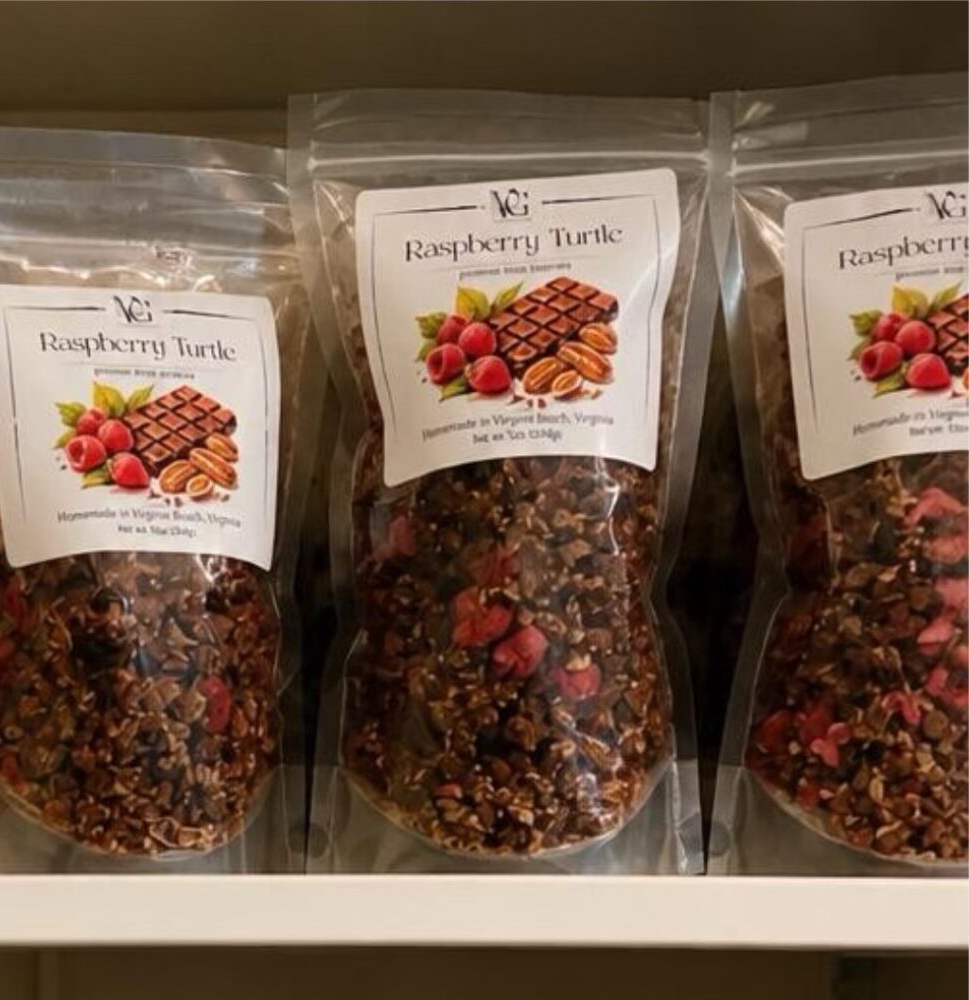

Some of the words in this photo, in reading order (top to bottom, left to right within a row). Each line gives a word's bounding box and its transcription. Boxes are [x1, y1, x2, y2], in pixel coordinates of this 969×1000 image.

[405, 233, 539, 262] Raspberry
[549, 224, 623, 248] Turtle
[39, 331, 166, 361] Raspberry
[172, 335, 237, 362] Turtle
